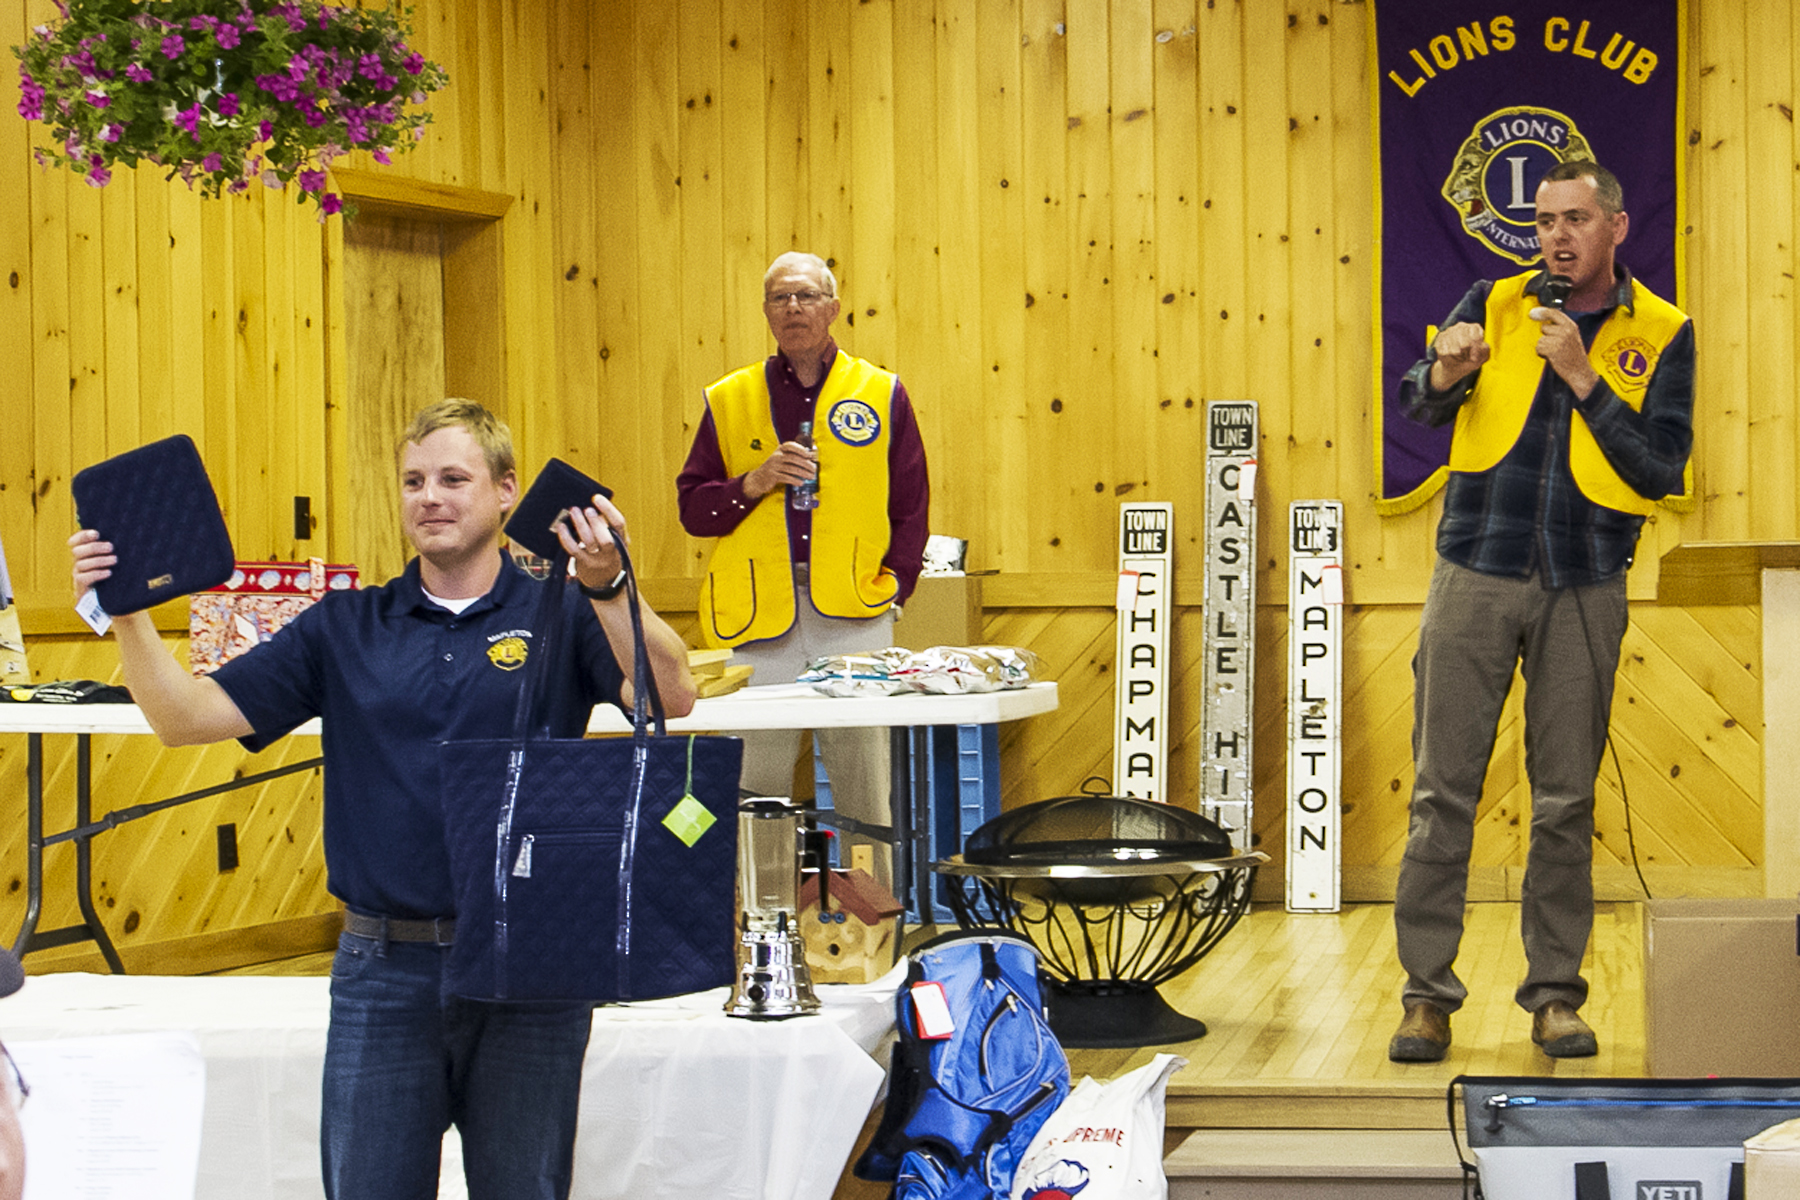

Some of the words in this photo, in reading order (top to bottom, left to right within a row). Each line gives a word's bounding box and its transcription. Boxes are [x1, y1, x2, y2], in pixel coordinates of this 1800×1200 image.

[1388, 15, 1517, 98] LIONS
[1543, 16, 1659, 85] CLUB
[1484, 118, 1565, 148] LIONS
[1505, 156, 1537, 210] L
[1623, 350, 1641, 374] L
[848, 412, 863, 429] L
[1212, 407, 1253, 427] TOWN
[1215, 428, 1248, 448] LINE
[1125, 511, 1167, 531] TOWN
[1128, 532, 1163, 552] LINE
[1216, 464, 1243, 674] CASTLE
[1298, 570, 1329, 851] MAPLETON
[1640, 1186, 1698, 1200] YETI
